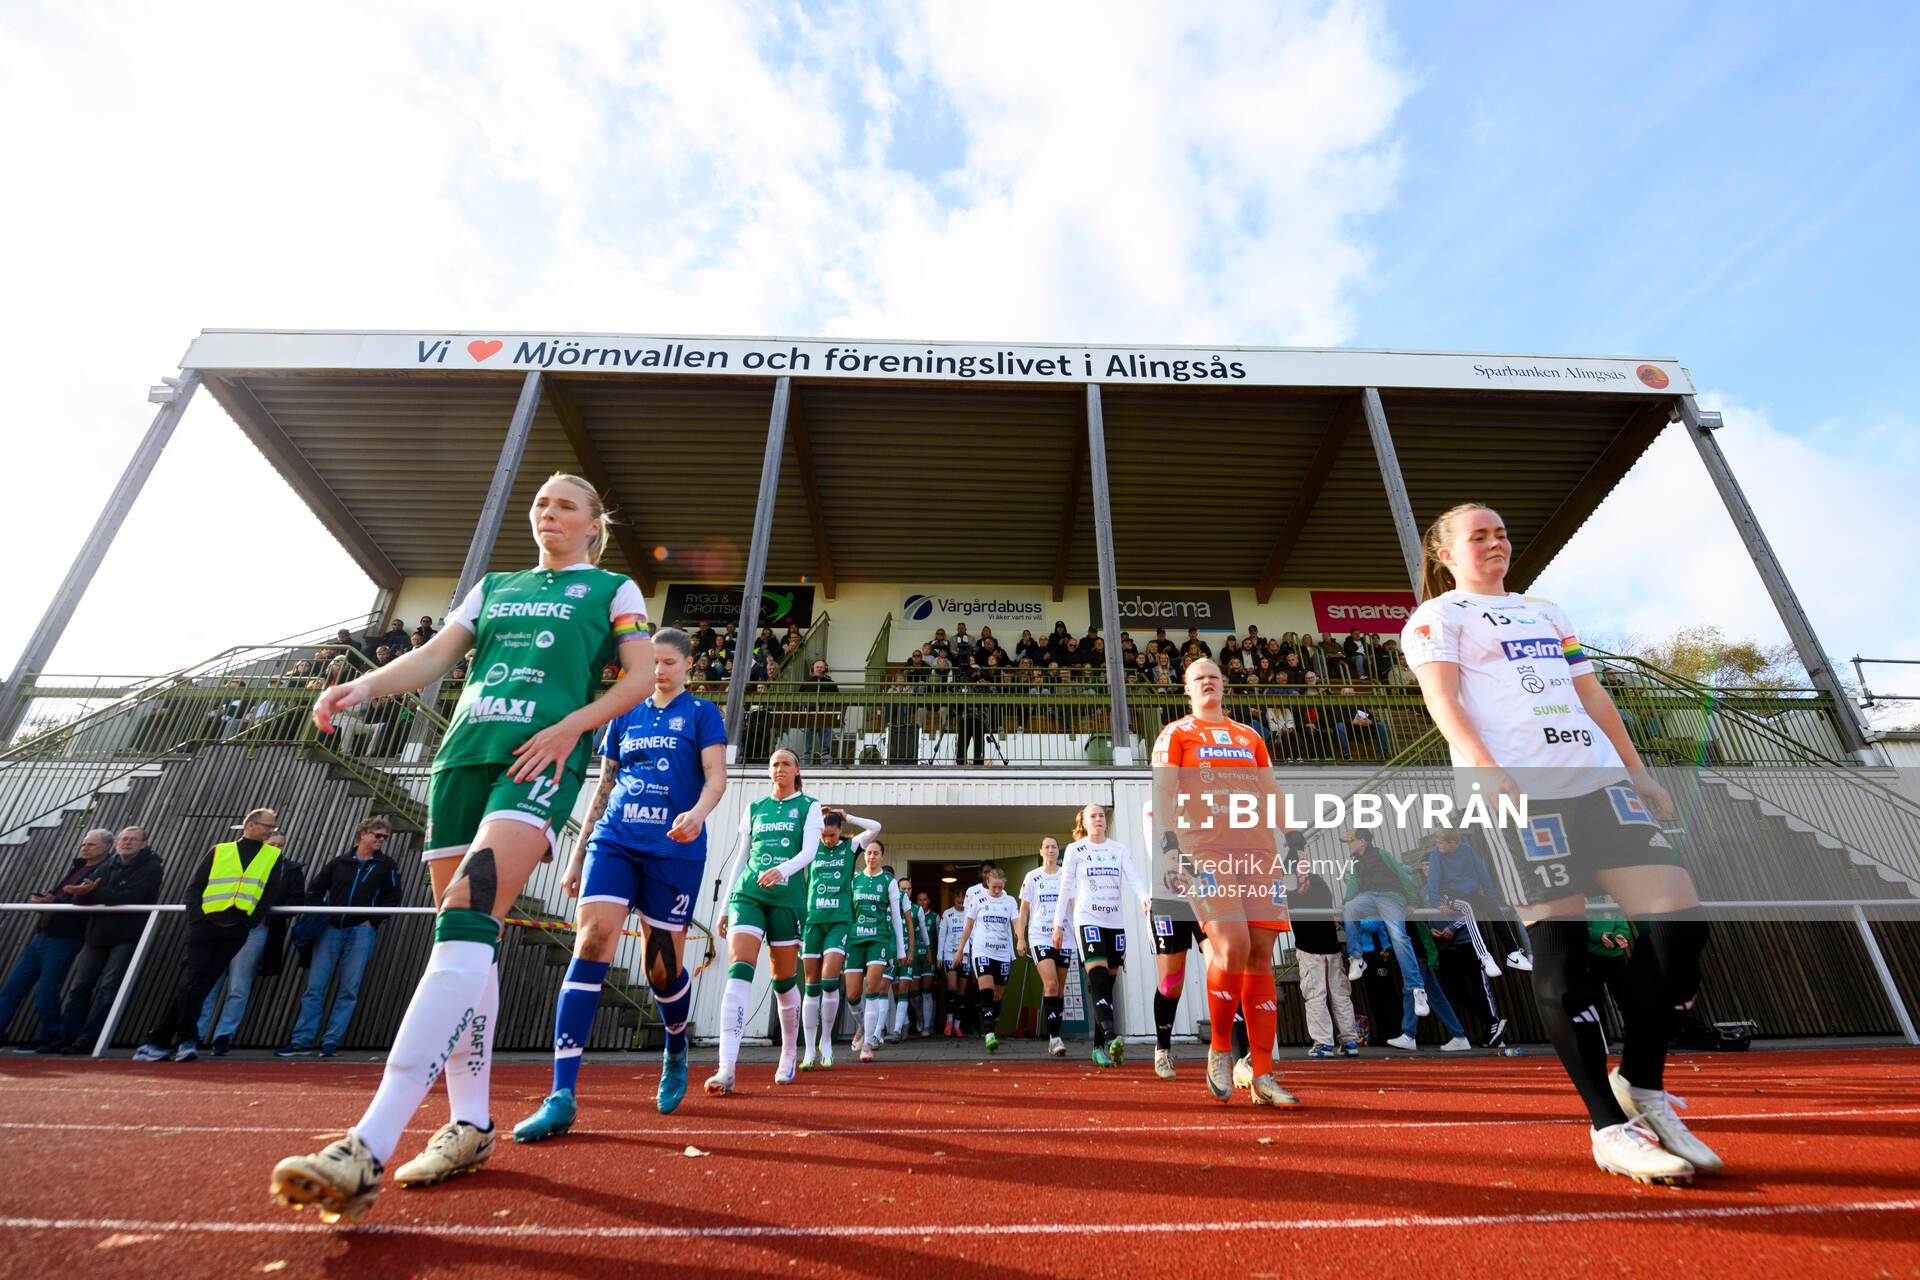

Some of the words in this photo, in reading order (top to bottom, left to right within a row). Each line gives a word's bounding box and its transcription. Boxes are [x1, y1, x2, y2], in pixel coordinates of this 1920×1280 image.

[418, 340, 451, 363] Vi
[513, 340, 729, 368] Mjörnvallen
[743, 347, 810, 370] och
[825, 348, 1072, 377] föreningslivet
[1084, 353, 1092, 376] i
[1106, 354, 1246, 382] Alingsås
[1474, 364, 1560, 380] Sparbanken
[487, 602, 574, 620] SERNEKE
[937, 599, 1042, 615] Vårgårdabuss
[1482, 612, 1511, 626] 13
[469, 696, 536, 717] MAXI
[1533, 704, 1570, 716] SUNNE
[624, 736, 677, 753] SERNEKE
[1543, 727, 1597, 746] Berg
[1200, 748, 1254, 759] Helmia
[527, 775, 559, 808] 12
[624, 803, 668, 819] MAXI
[1534, 863, 1570, 888] 13
[816, 898, 839, 906] MAXI
[1087, 944, 1094, 952] 4
[1158, 936, 1165, 950] 2
[881, 948, 886, 957] 6
[470, 1015, 487, 1058] CRAFT
